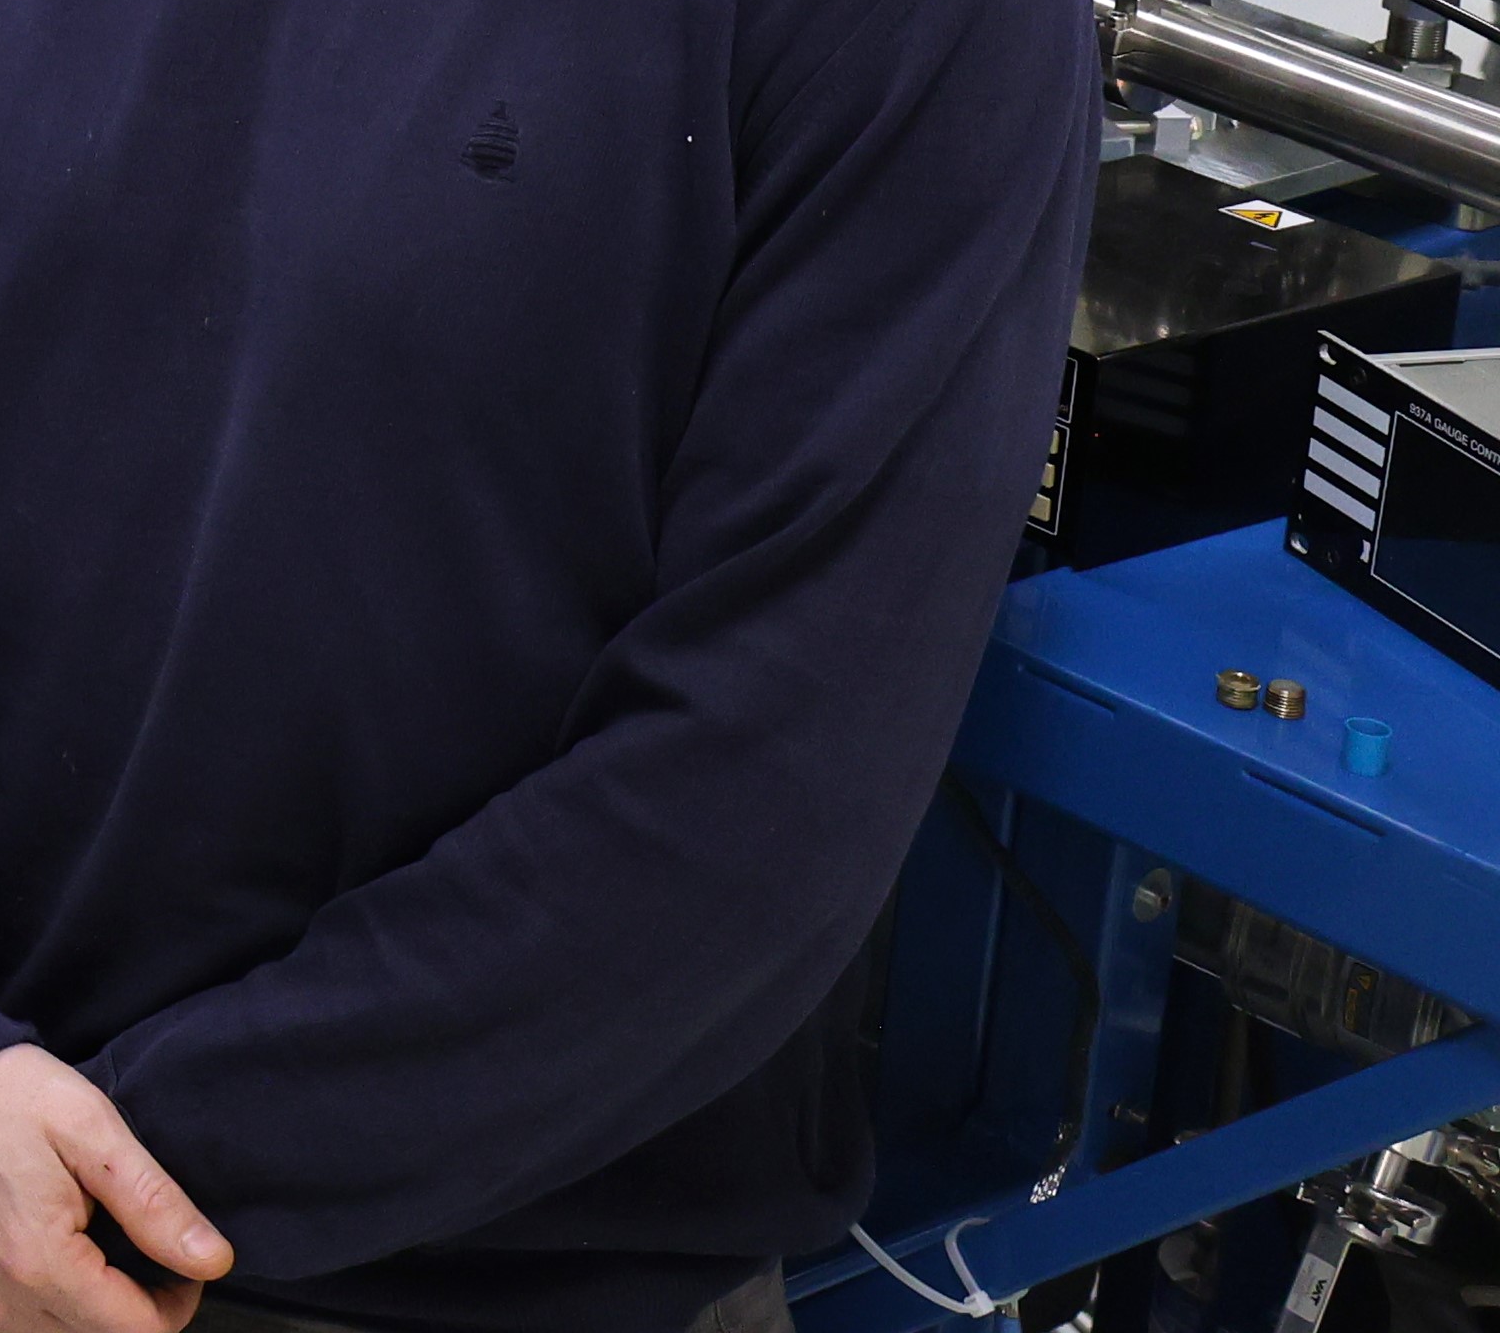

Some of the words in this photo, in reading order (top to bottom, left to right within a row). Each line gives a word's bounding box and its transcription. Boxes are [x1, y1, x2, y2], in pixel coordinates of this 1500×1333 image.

[1408, 402, 1432, 424] 937A
[1433, 417, 1470, 447] GAUGE
[1310, 1279, 1328, 1307] VAT
